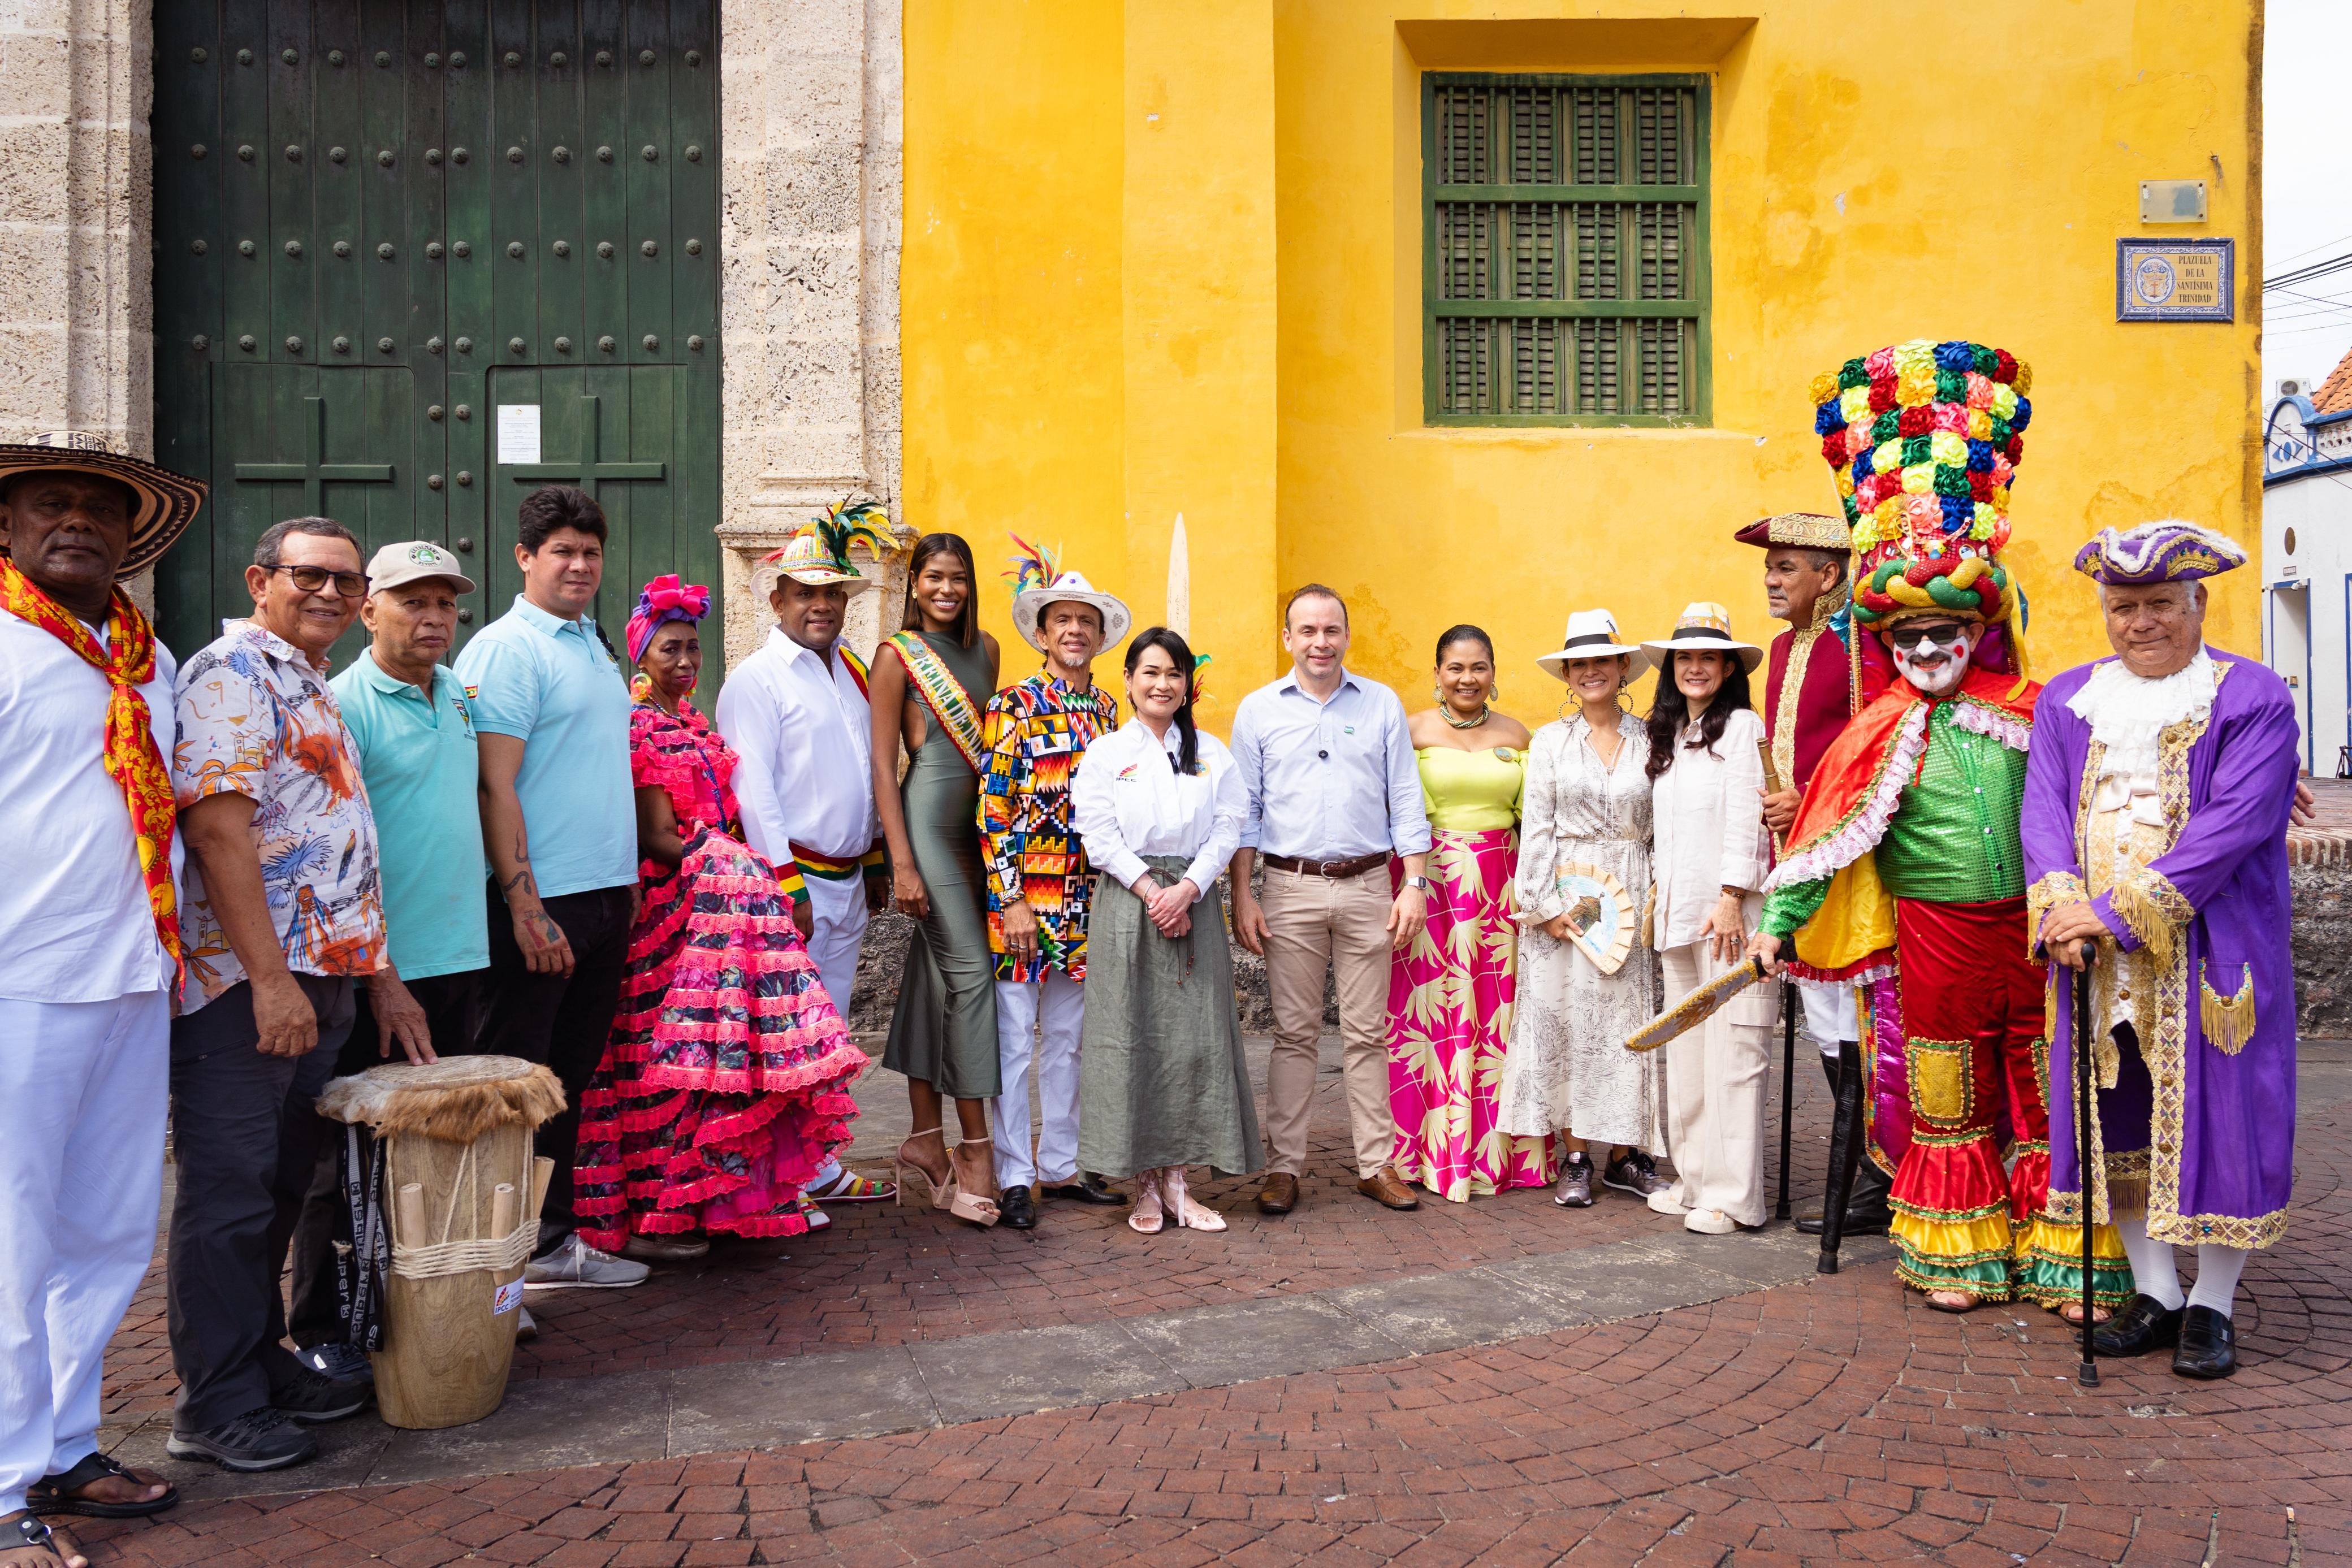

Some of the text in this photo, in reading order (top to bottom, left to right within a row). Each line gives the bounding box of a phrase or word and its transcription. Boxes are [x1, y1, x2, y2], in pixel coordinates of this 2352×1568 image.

[2178, 255, 2212, 265] PLAZUELA
[2186, 268, 2204, 277] DE LA
[2177, 279, 2213, 290] SANTÍSIMA
[2178, 294, 2211, 302] TRINIDAD
[910, 653, 960, 711] REINA
[495, 1303, 509, 1313] IPCC
